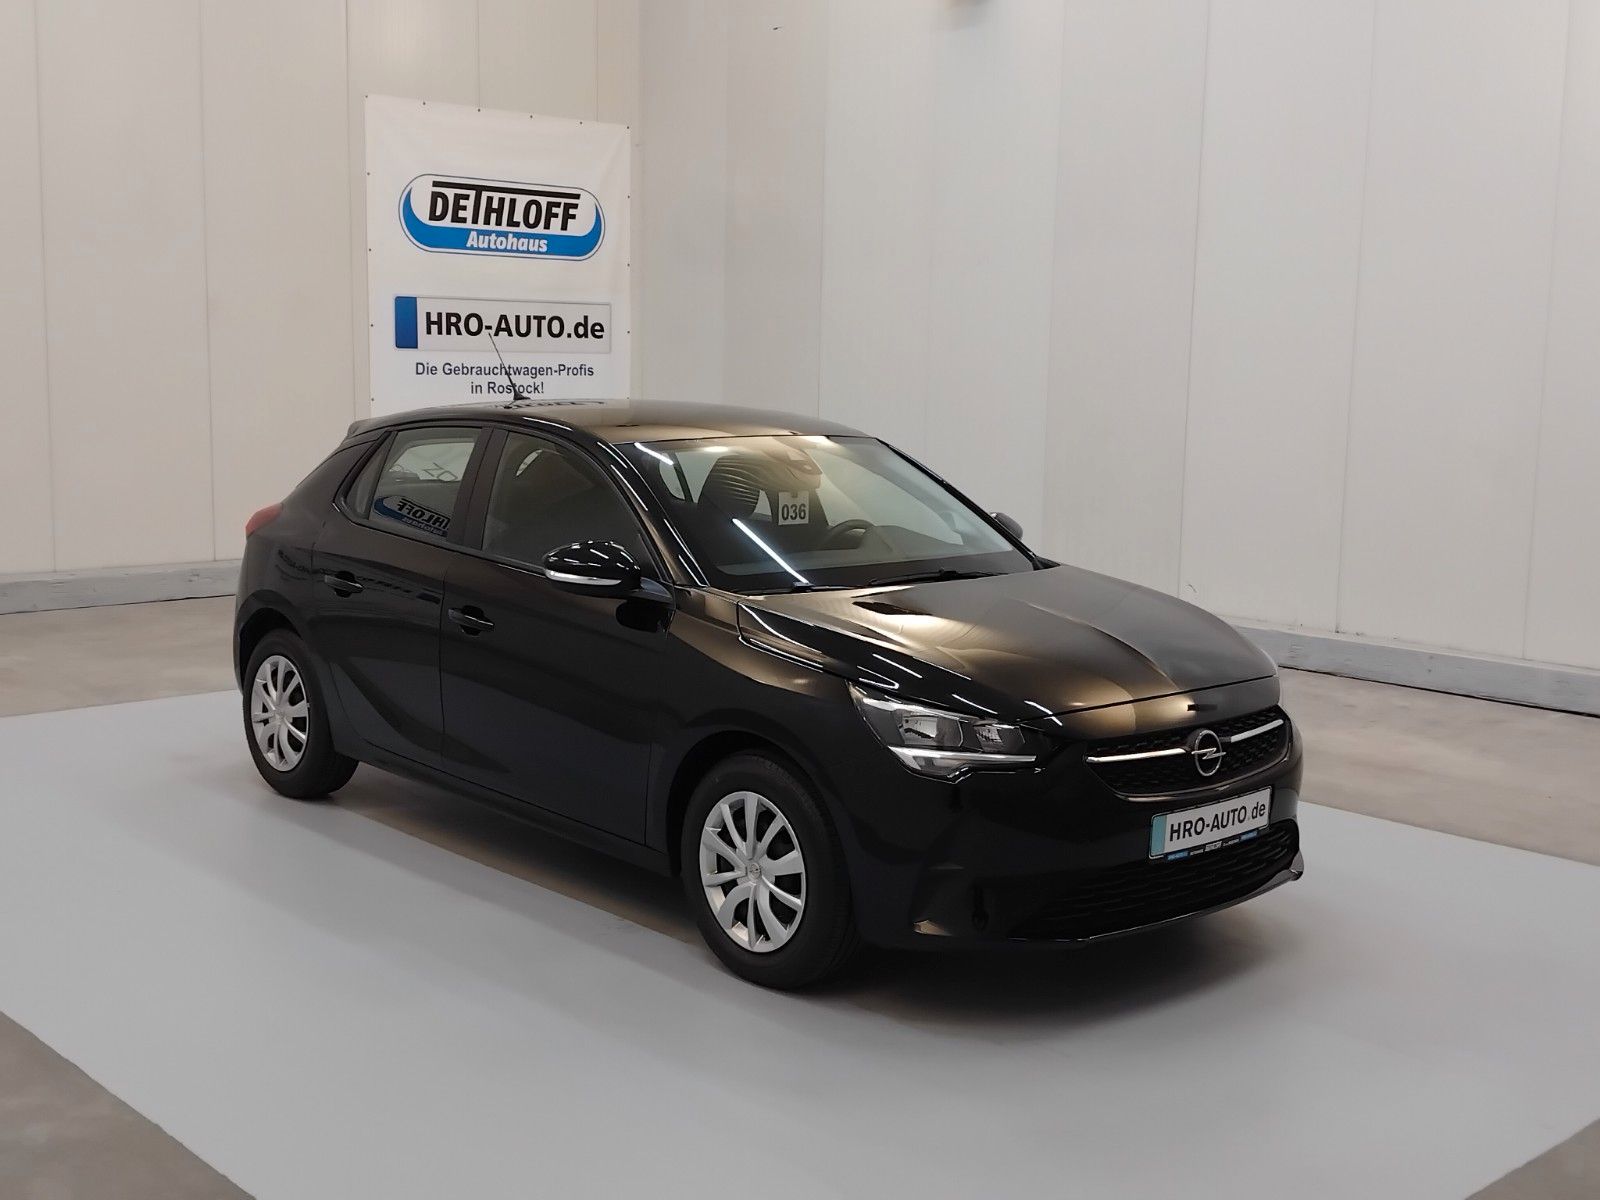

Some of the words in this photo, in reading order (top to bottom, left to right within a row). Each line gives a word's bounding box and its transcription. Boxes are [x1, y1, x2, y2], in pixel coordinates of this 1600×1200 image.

[428, 181, 581, 231] DETHLOFF
[466, 231, 548, 252] Autohaus
[425, 311, 605, 339] HRO-AUTO.de
[415, 362, 438, 376] Die
[442, 362, 594, 379] Gebrauchtwagen-Profis
[470, 382, 483, 394] in
[781, 503, 807, 521] 036
